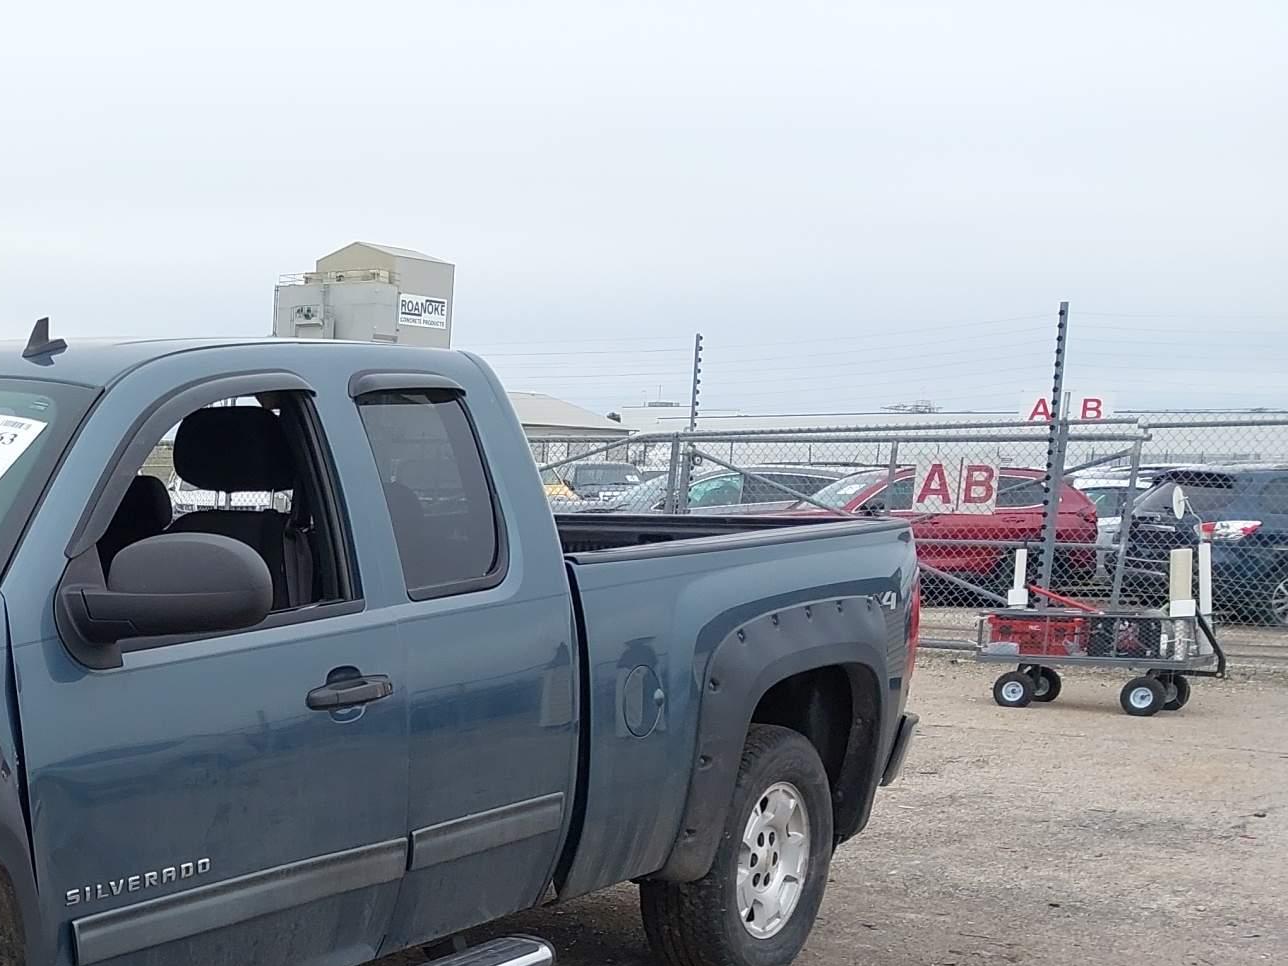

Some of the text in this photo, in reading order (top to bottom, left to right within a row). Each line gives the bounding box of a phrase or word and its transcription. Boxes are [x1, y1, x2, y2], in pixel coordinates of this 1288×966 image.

[401, 299, 445, 316] ROANOKE
[1029, 398, 1103, 421] A B
[916, 463, 996, 504] A B
[65, 857, 211, 907] SILVERADO
